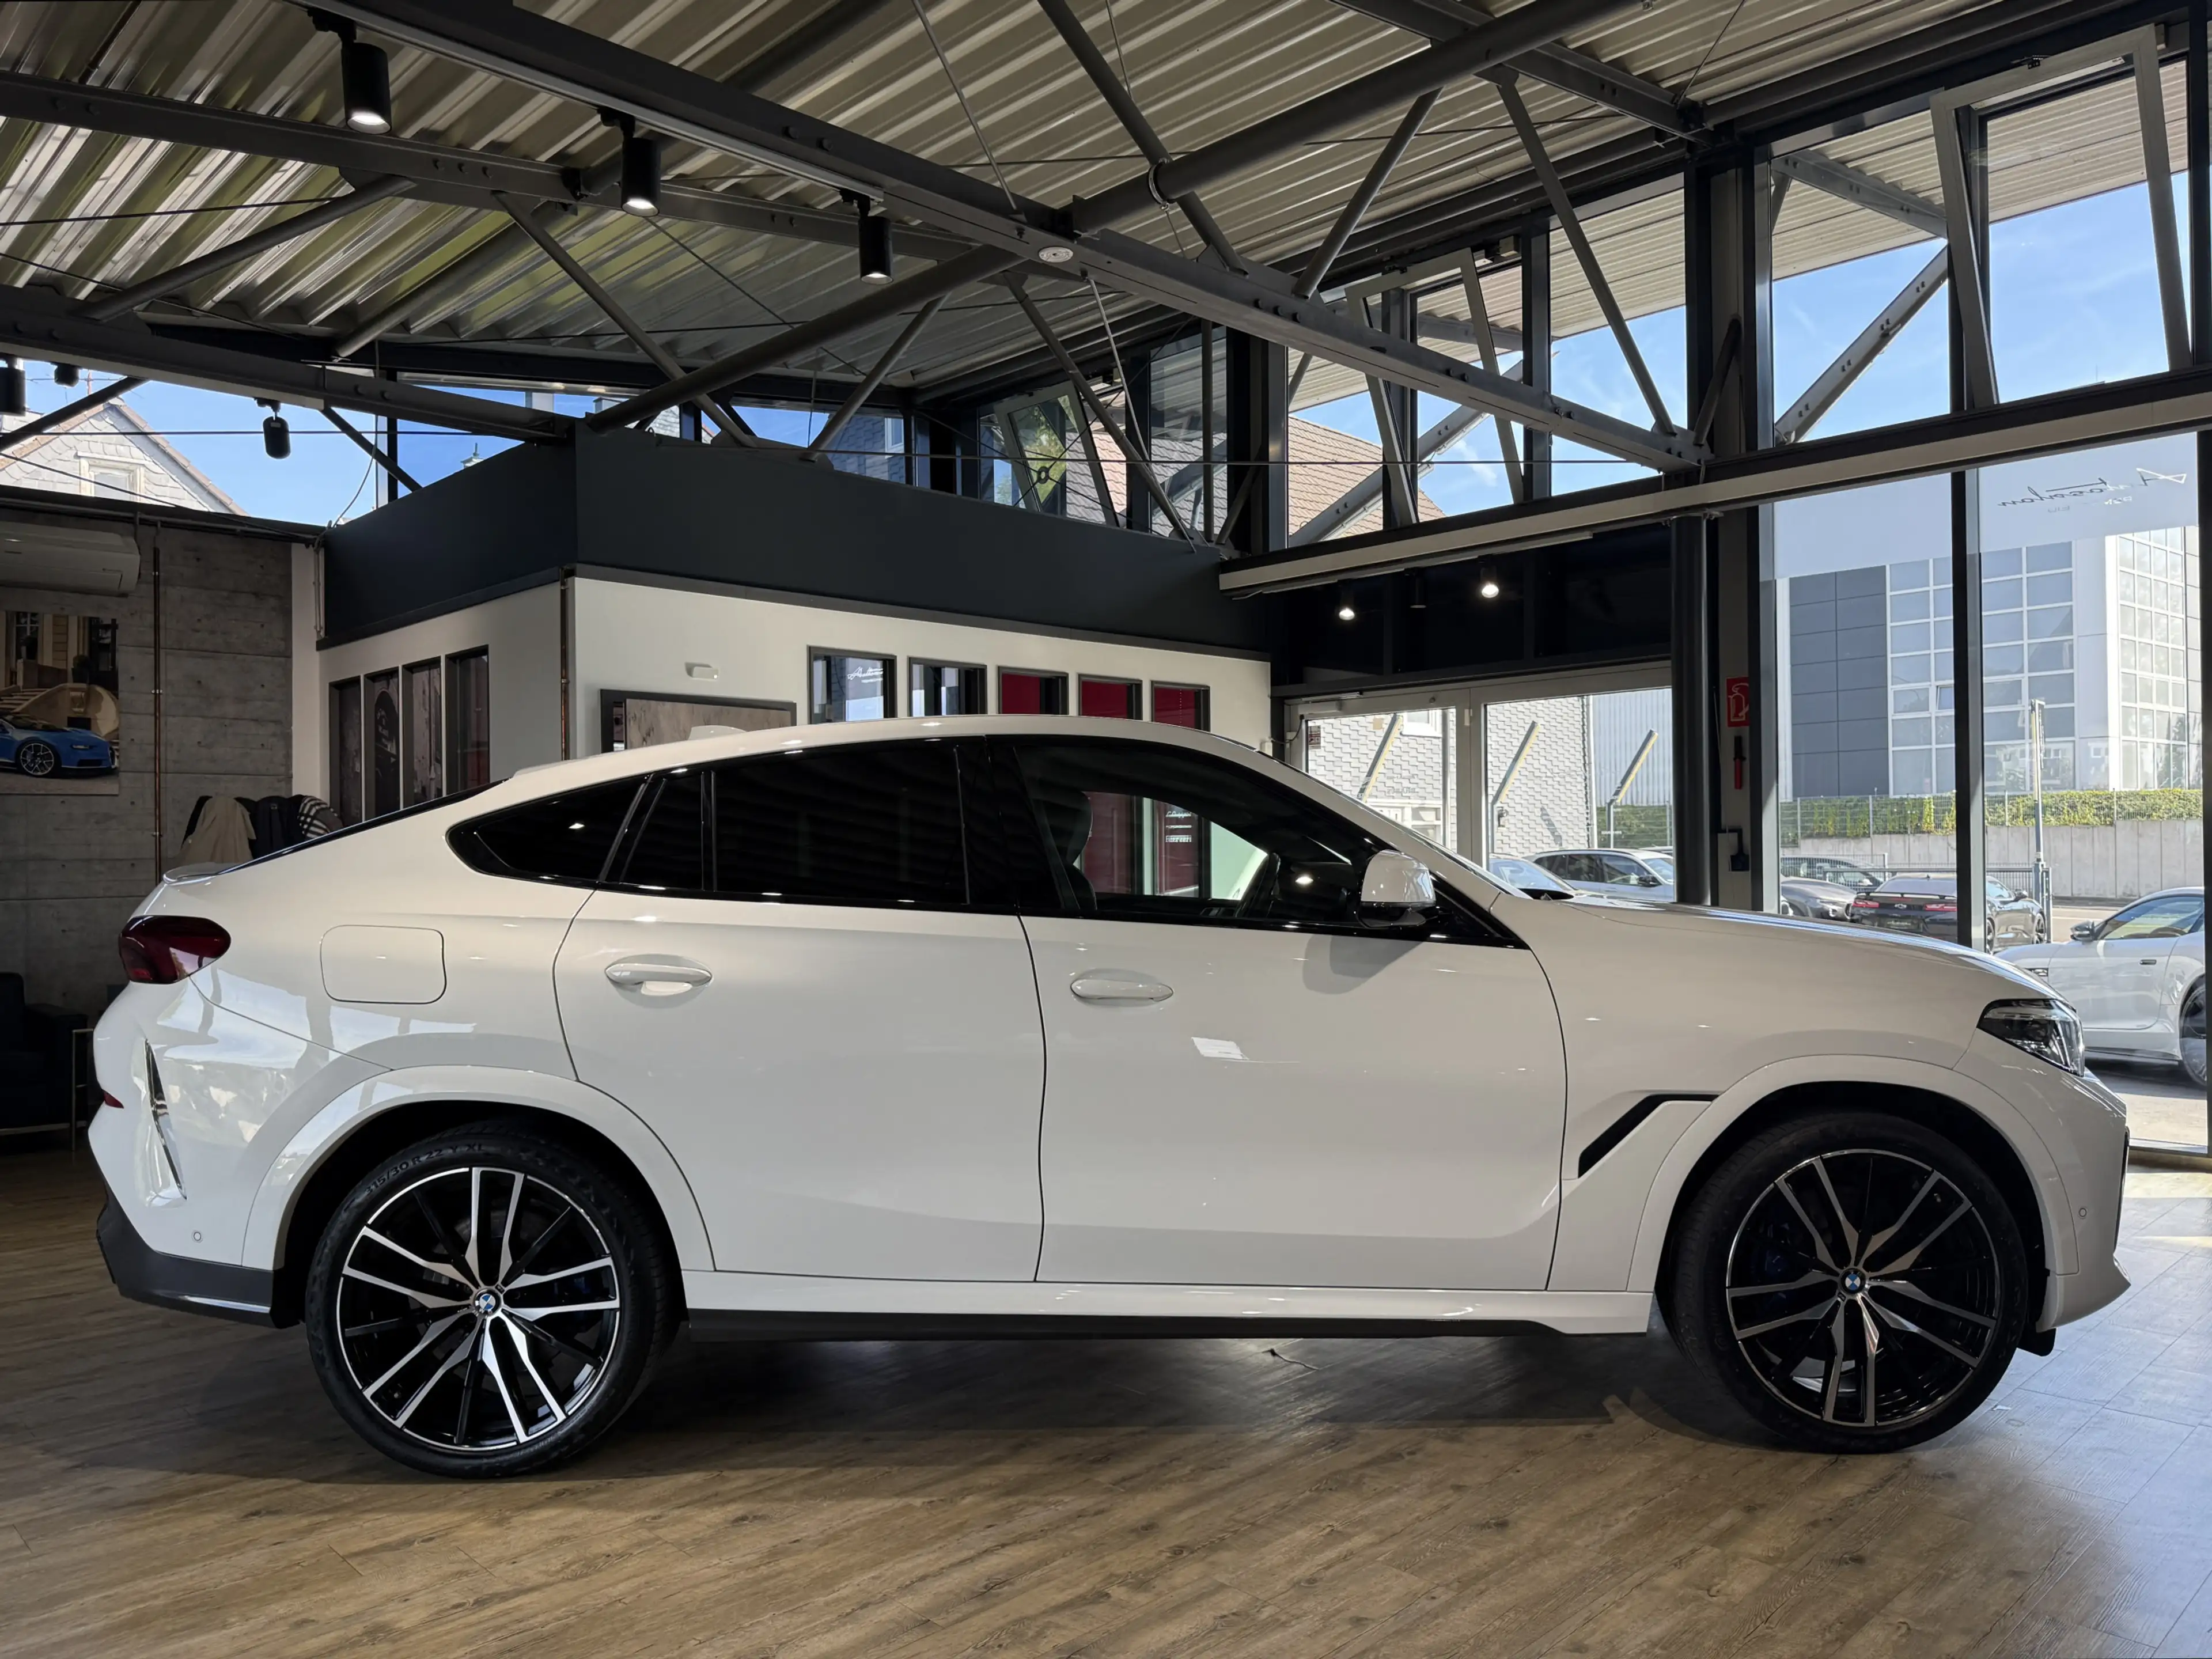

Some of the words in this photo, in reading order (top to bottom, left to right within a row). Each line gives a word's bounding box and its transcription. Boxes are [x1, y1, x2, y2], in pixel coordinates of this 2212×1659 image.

[364, 1161, 409, 1196] 315/30
[411, 1156, 422, 1165] R
[425, 1149, 443, 1160] 22
